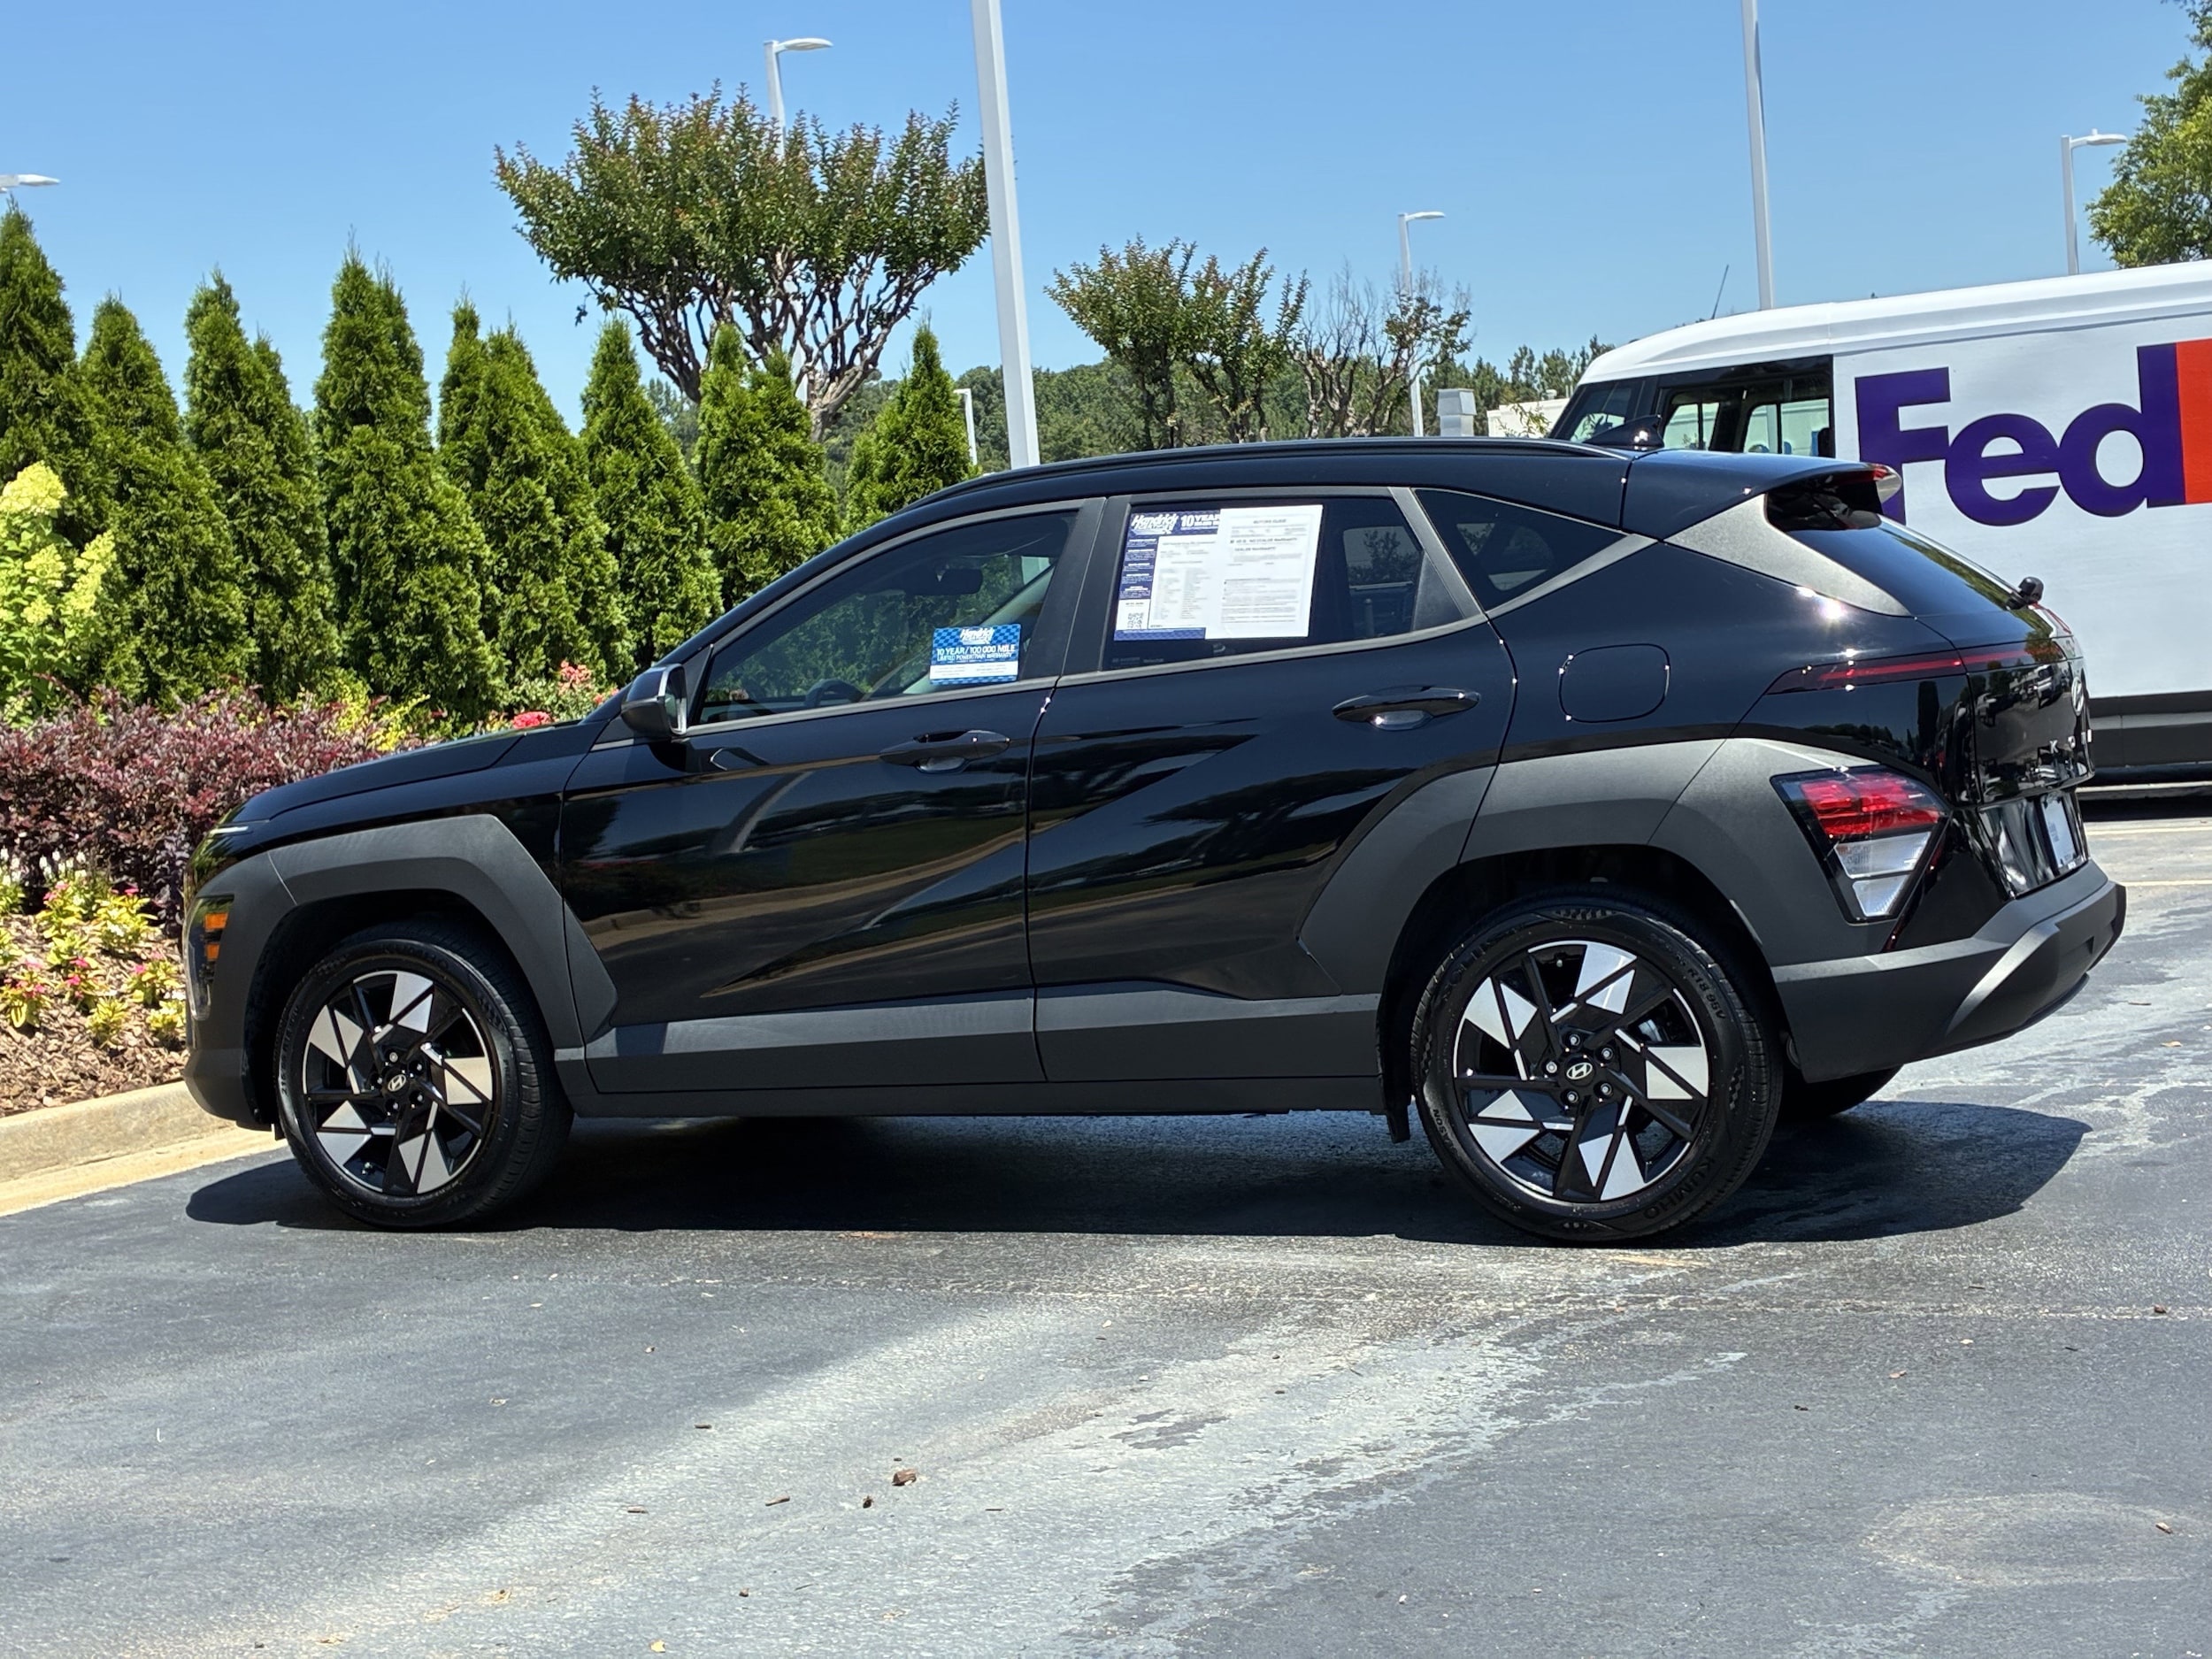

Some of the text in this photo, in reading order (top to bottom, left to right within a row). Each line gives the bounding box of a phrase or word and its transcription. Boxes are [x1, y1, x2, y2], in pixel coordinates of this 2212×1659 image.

[1180, 515, 1194, 526] 10
[1687, 968, 1726, 1019] R18 95V
[1643, 1154, 1715, 1219] KUMHO
